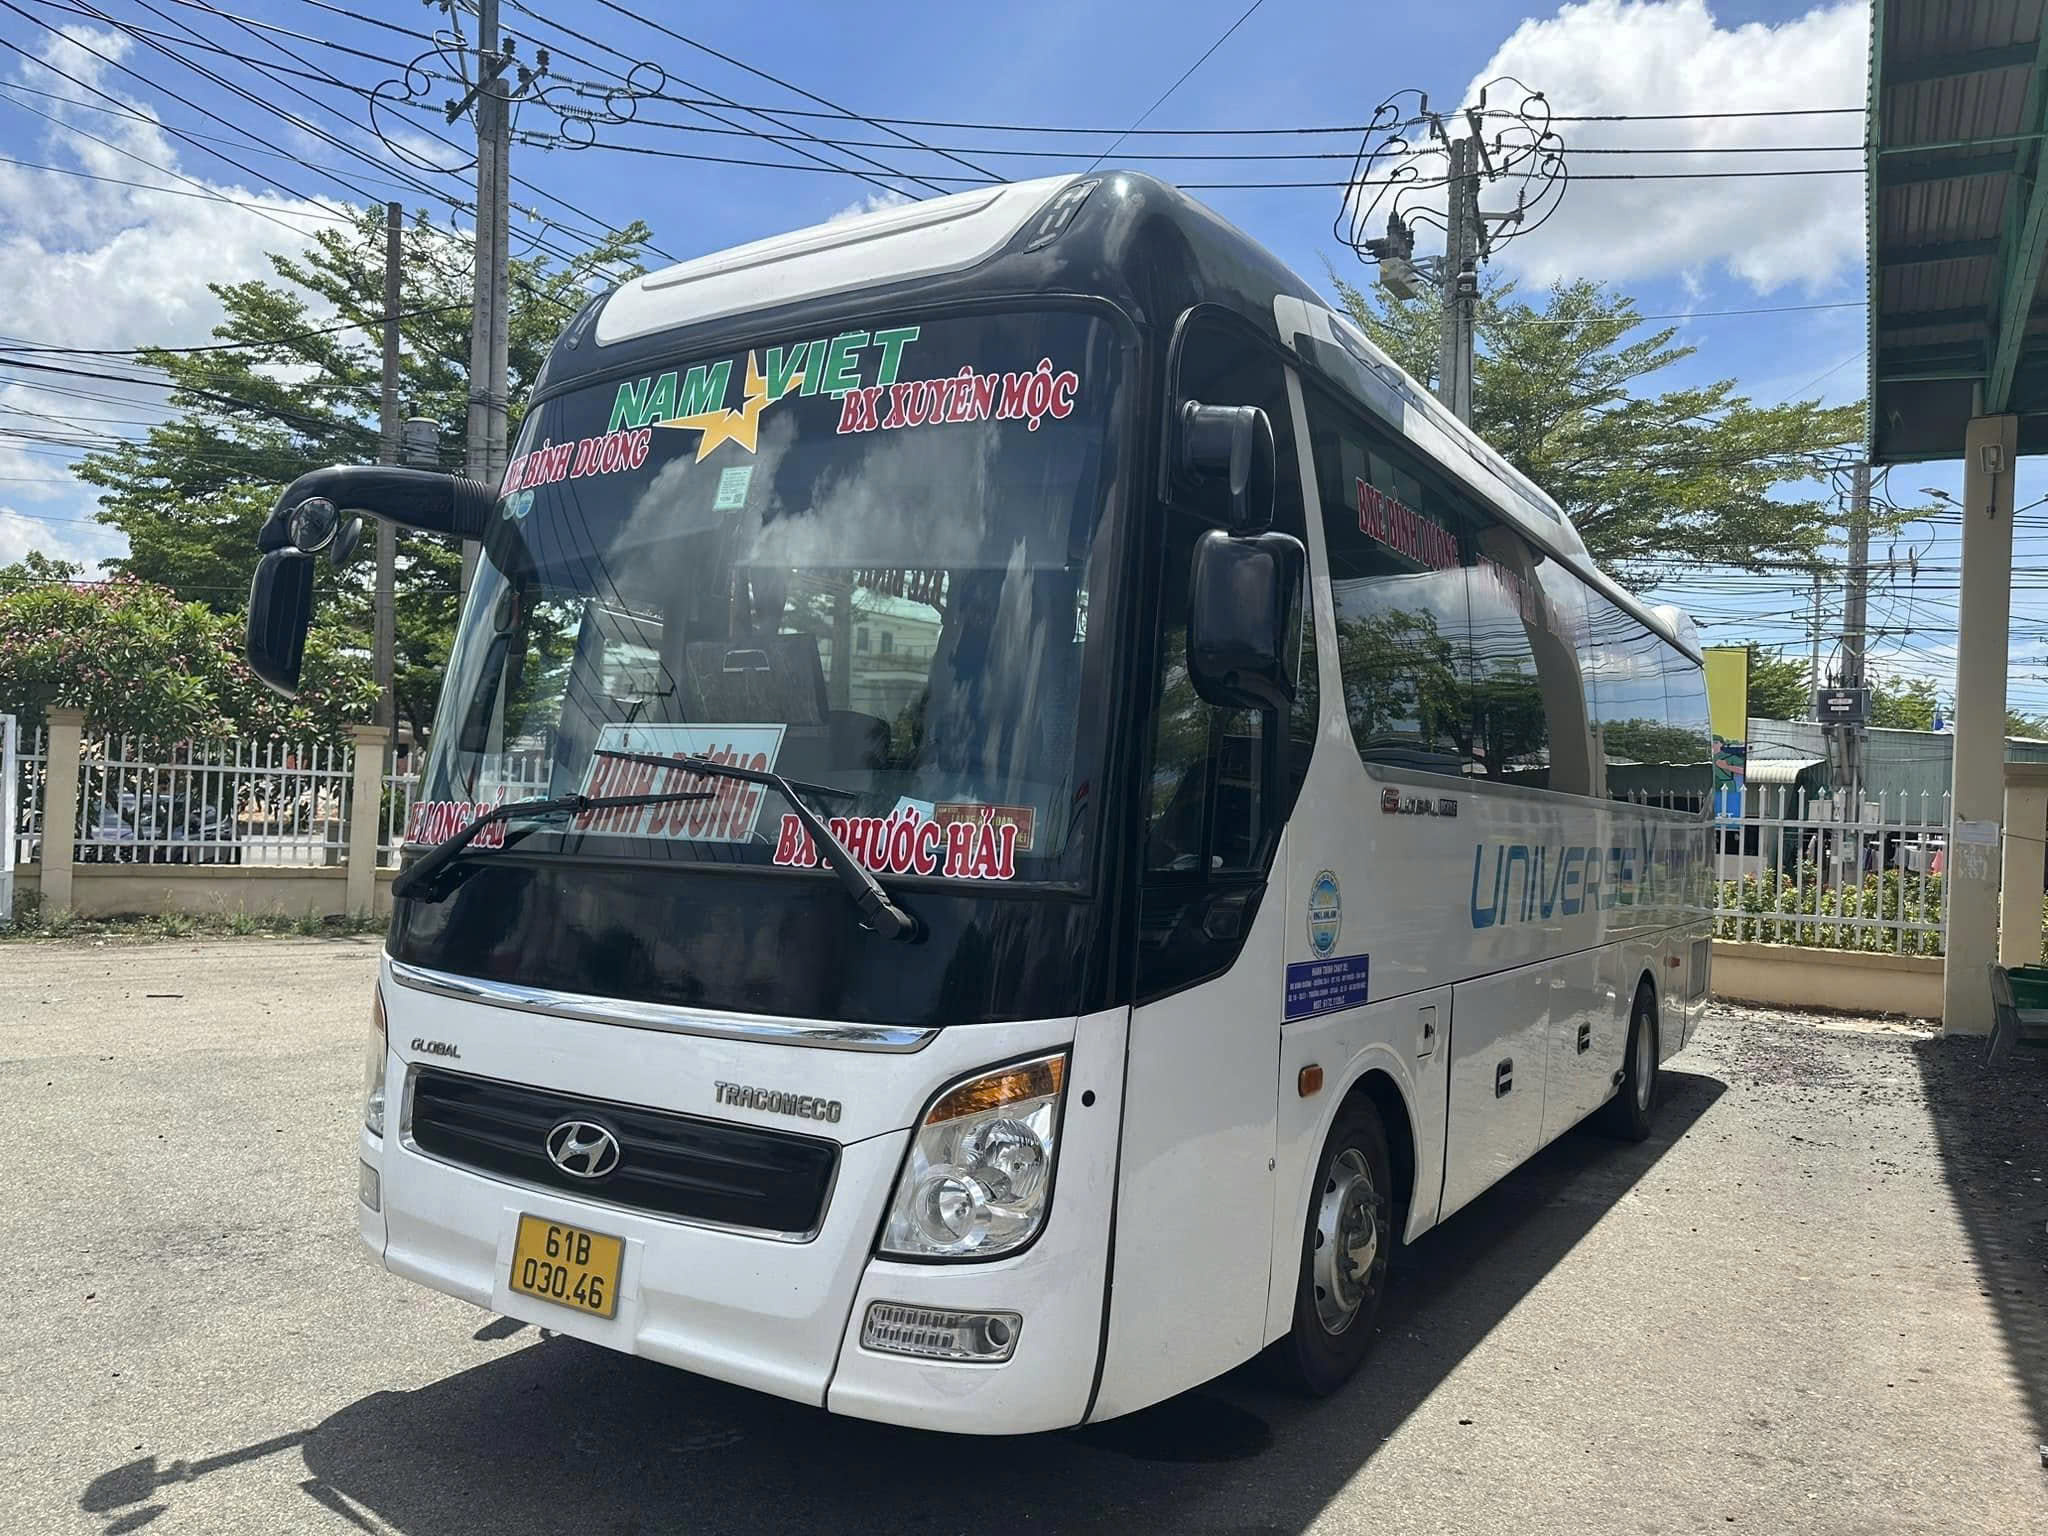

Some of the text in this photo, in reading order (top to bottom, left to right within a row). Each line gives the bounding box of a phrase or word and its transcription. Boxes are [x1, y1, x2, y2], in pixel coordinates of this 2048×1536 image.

[607, 329, 920, 431] NAM VIỆT
[837, 357, 1079, 434] BX XUYÊN MỘC
[942, 806, 1018, 880] HẢI
[411, 1038, 461, 1059] GLOBAL
[714, 1080, 842, 1123] TRACOMECO
[546, 1226, 592, 1266] 61B
[523, 1258, 604, 1309] 030.46
